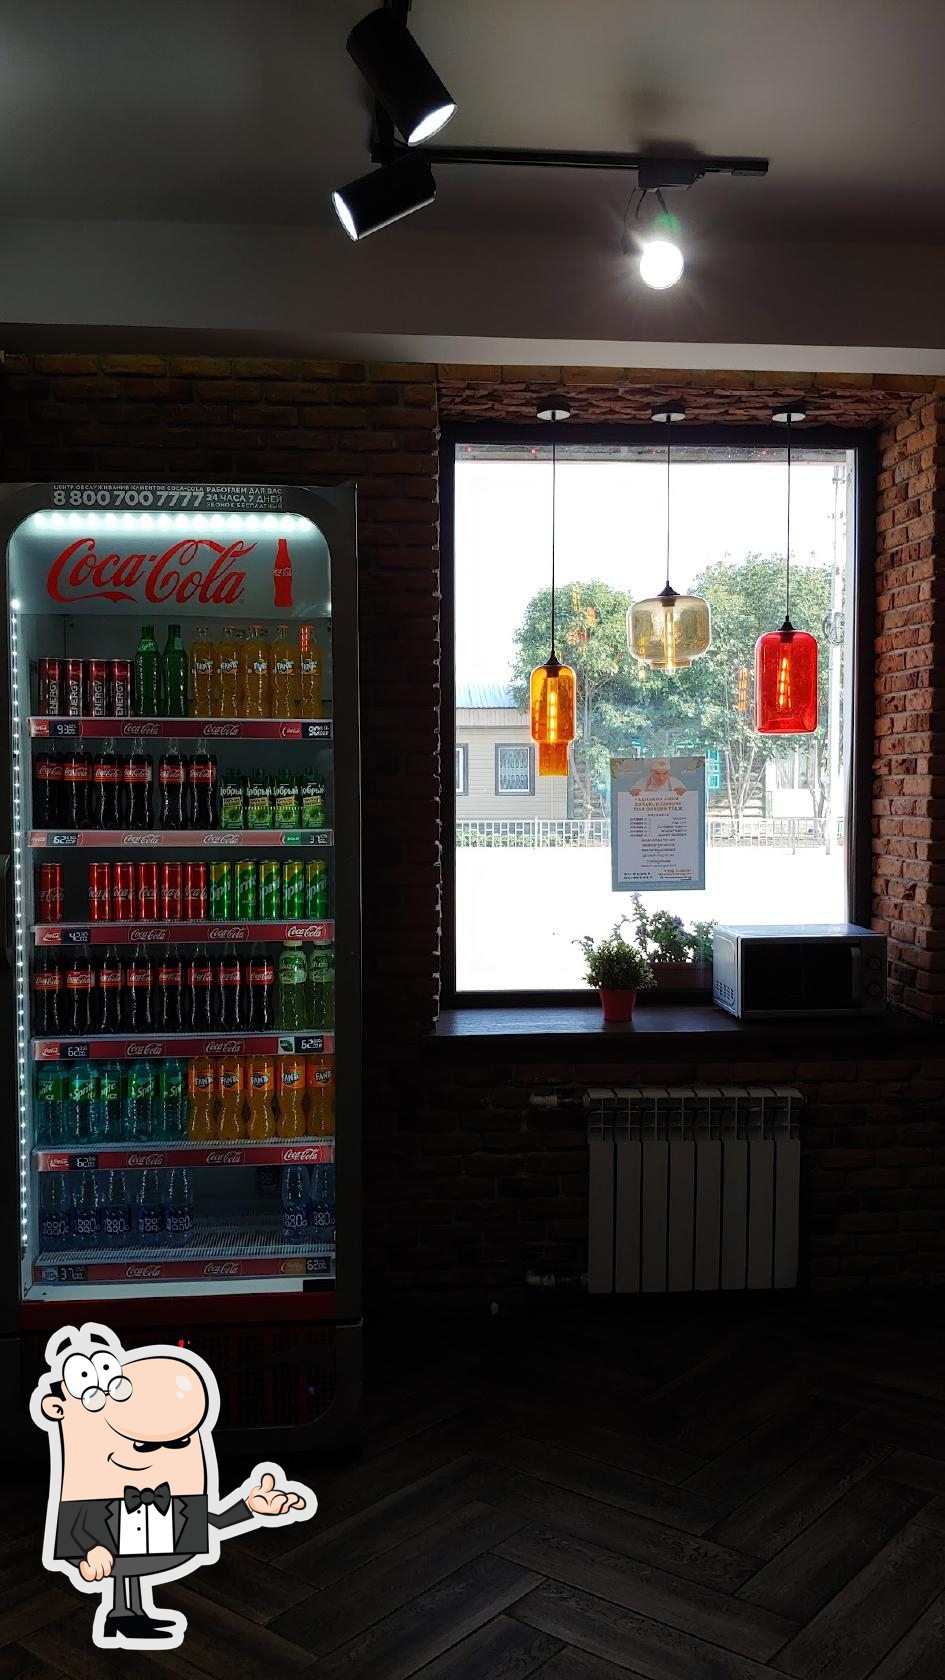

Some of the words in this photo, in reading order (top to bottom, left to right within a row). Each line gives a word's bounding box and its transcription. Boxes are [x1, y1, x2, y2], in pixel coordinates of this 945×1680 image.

[53, 490, 66, 506] 8
[69, 490, 111, 506] 800
[113, 490, 154, 506] 700
[156, 490, 204, 507] 7777
[206, 486, 247, 494] РАБОТАЕМ
[248, 487, 265, 495] ДЛЯ
[220, 494, 246, 502] ЧАСА
[256, 494, 282, 503] ДНЕЙ
[47, 537, 258, 604] Coca-Cola
[50, 679, 58, 715] ENERGY
[70, 680, 79, 716] ENERGY
[94, 680, 103, 716] ENERGY
[115, 680, 124, 716] ENERGY
